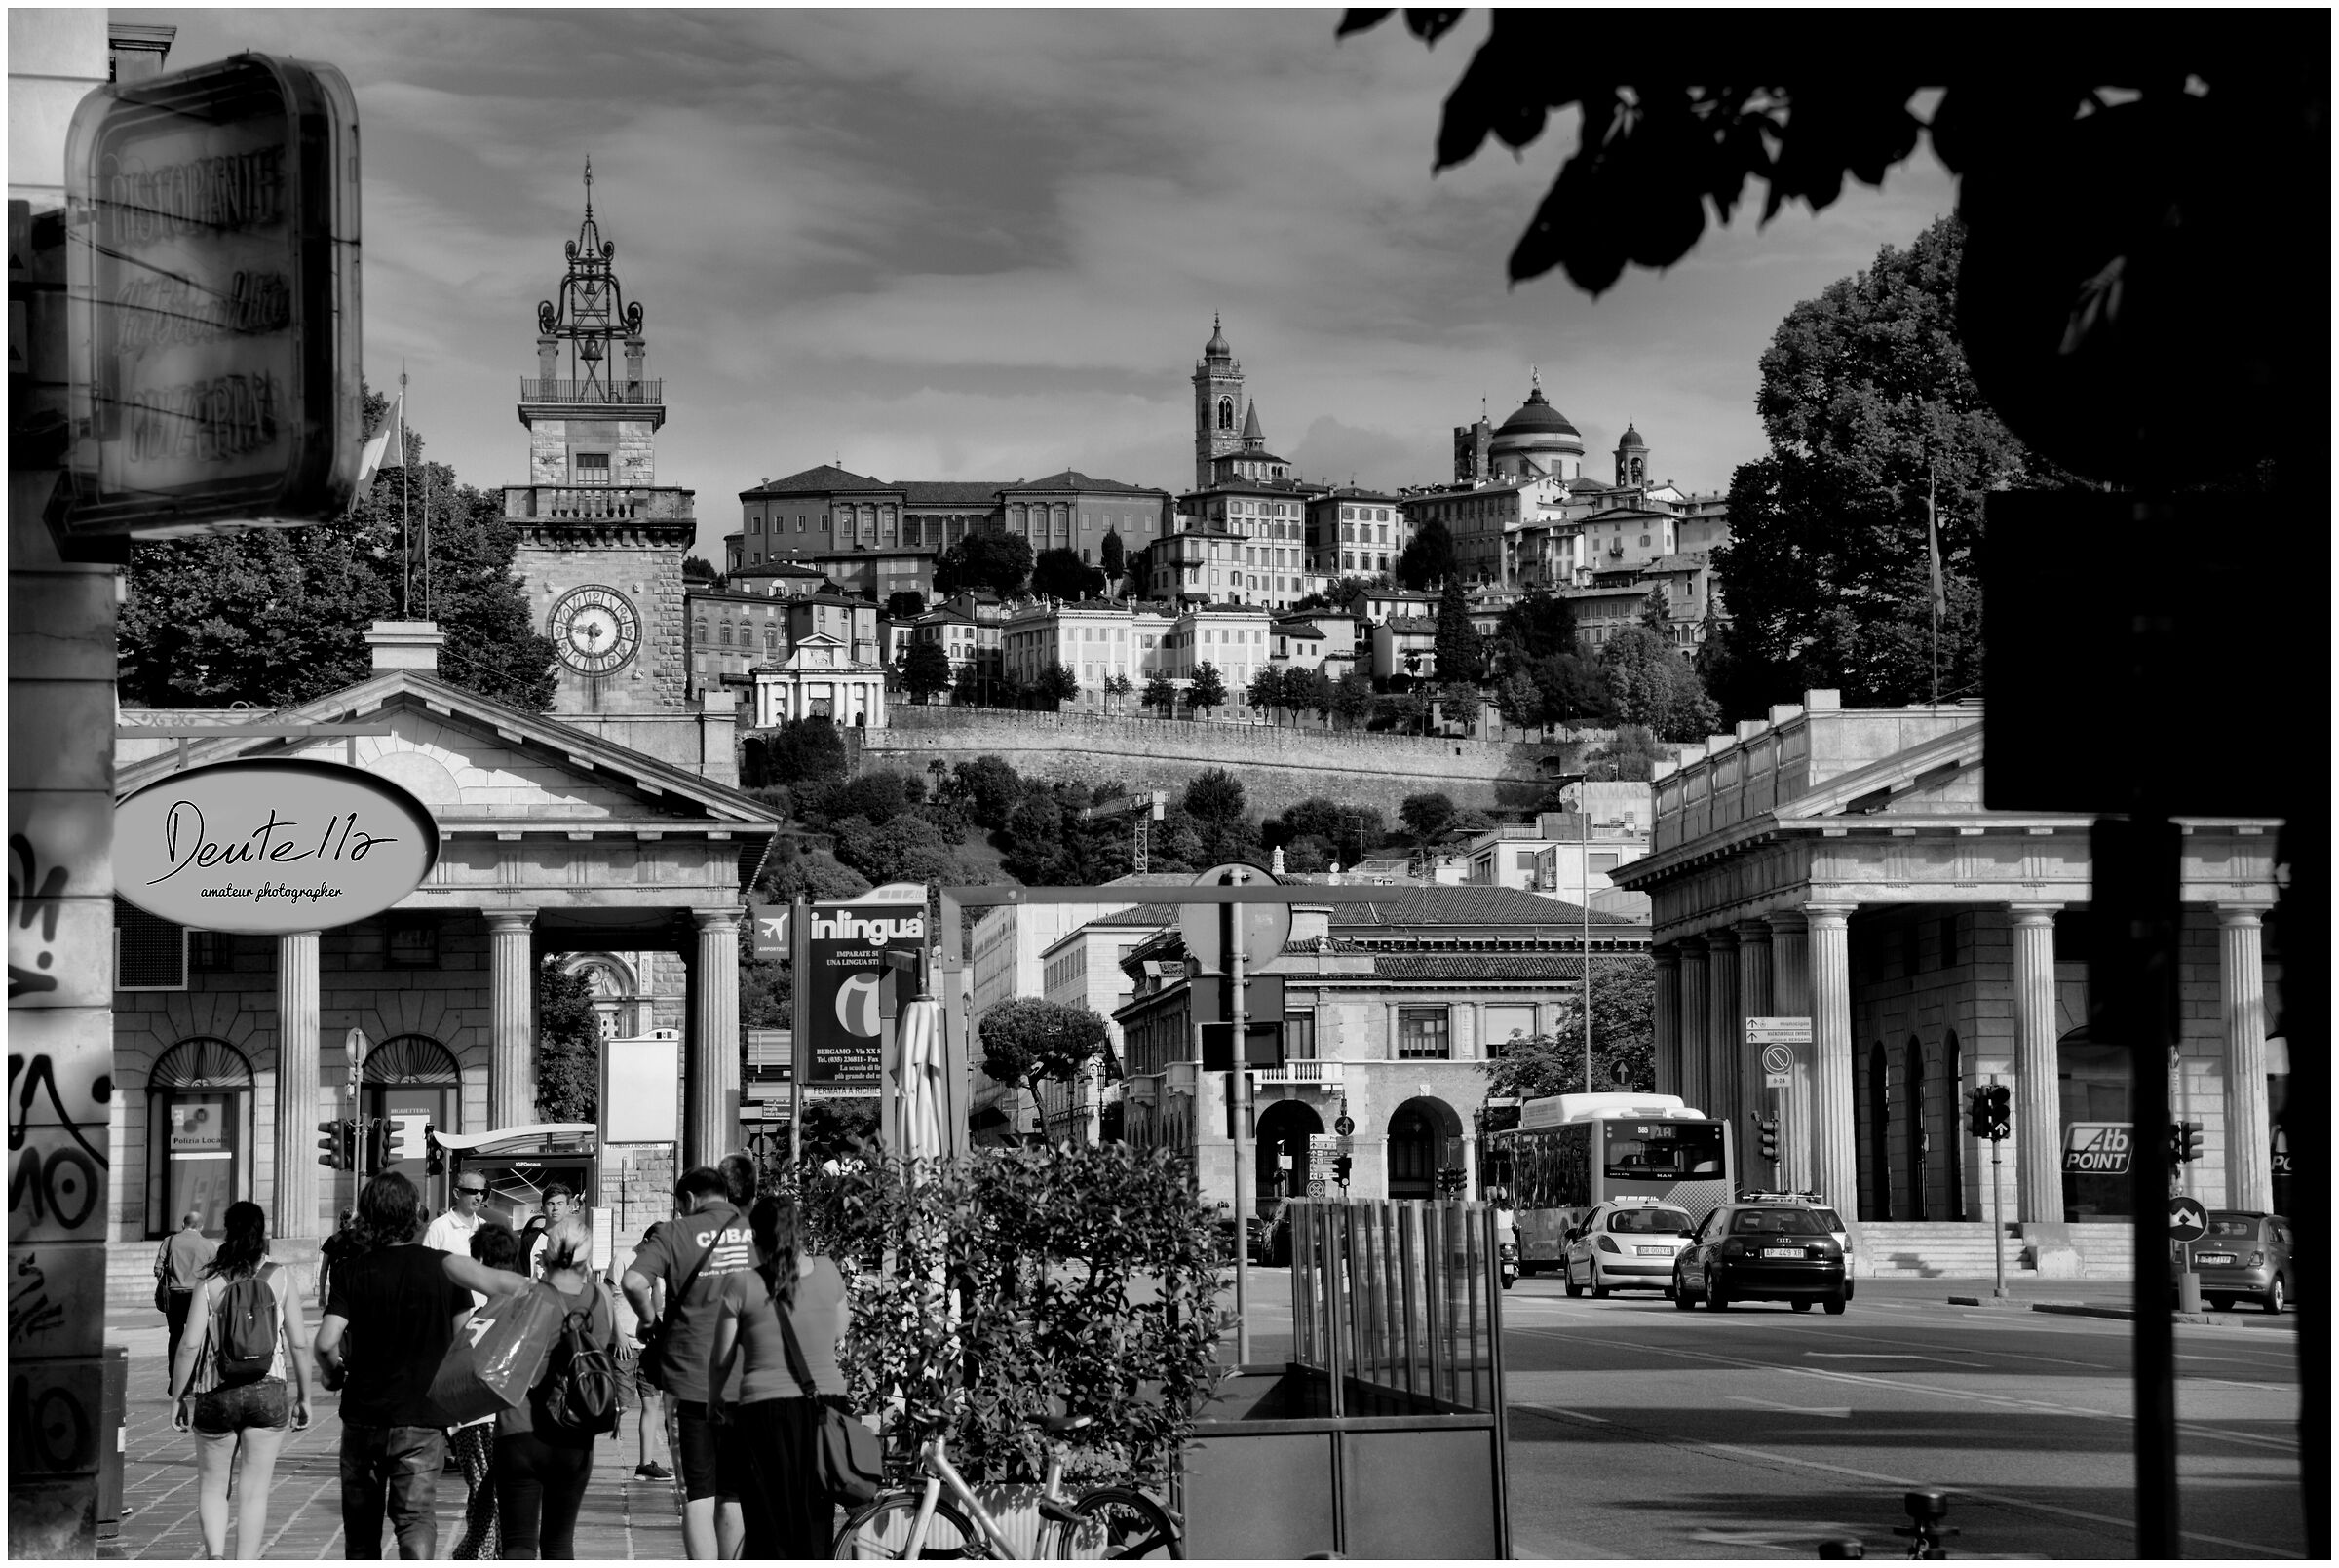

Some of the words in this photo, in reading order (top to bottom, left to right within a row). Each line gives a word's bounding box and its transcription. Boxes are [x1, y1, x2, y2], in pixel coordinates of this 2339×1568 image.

[572, 595, 581, 610] 11
[588, 593, 600, 604] 12
[609, 596, 614, 611] 1
[558, 608, 571, 622] 10
[619, 607, 628, 623] 2
[556, 625, 563, 638] 9
[559, 642, 568, 657] 8
[620, 642, 627, 658] 4
[573, 655, 581, 668] 7
[608, 655, 616, 667] 5
[811, 910, 924, 946] inlingua
[814, 1086, 846, 1094] FERMATA
[1637, 1126, 1649, 1134] 585
[2066, 1153, 2126, 1169] POINT
[696, 1228, 753, 1248] CUBA
